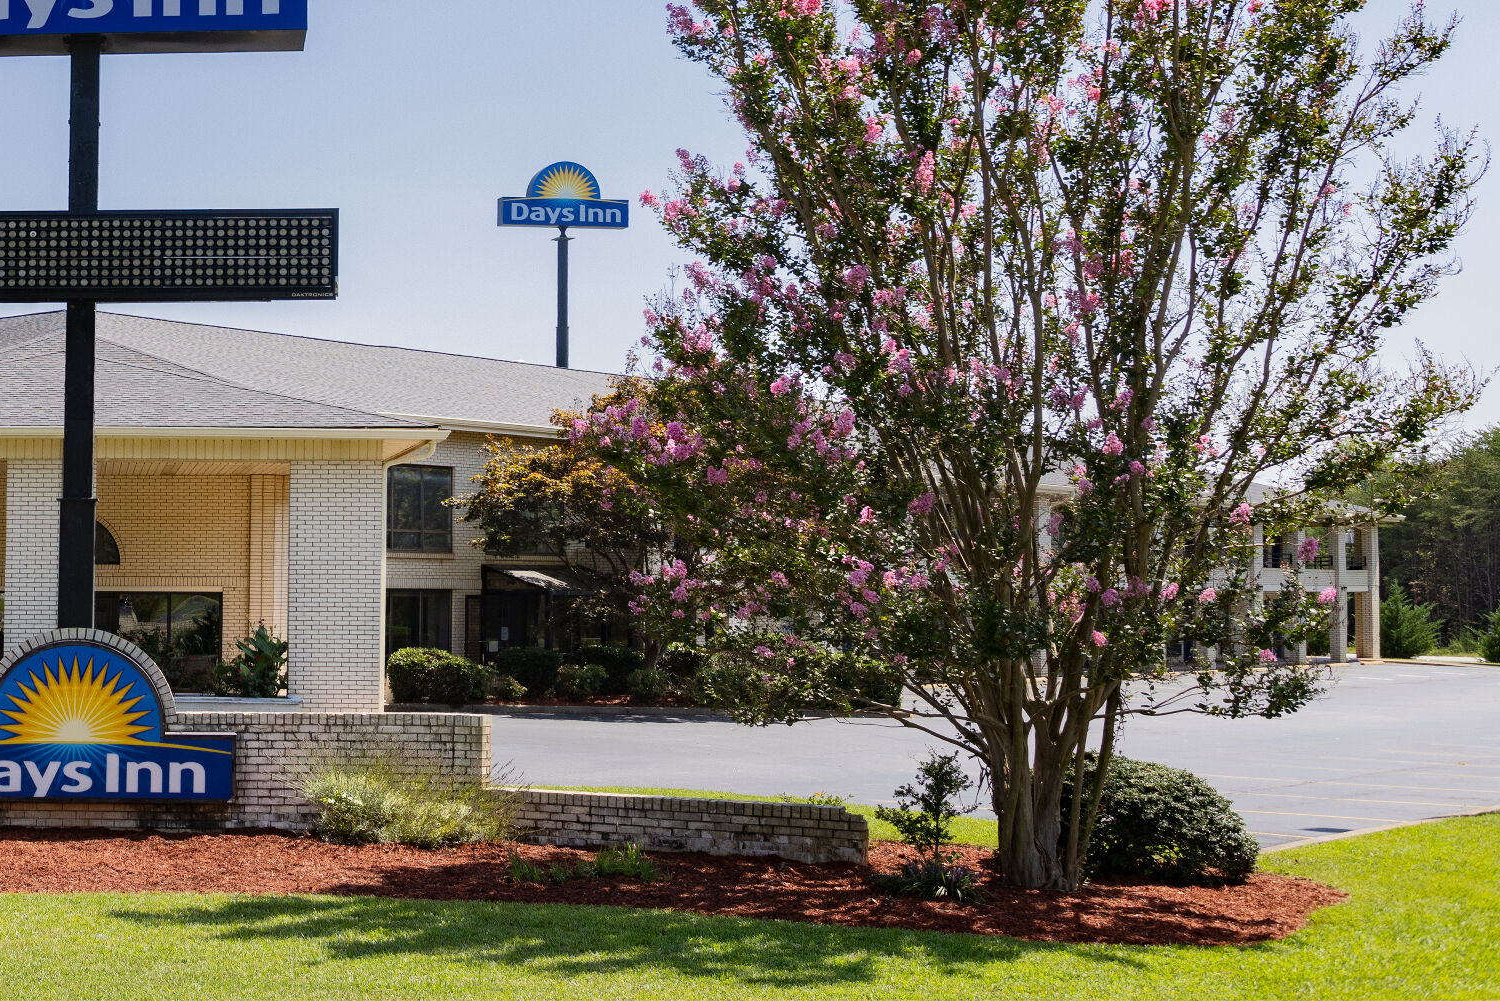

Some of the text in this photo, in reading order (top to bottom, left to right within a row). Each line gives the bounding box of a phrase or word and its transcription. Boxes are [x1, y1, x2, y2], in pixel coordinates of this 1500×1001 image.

[511, 202, 622, 224] Days Inn
[106, 752, 206, 794] Inn
